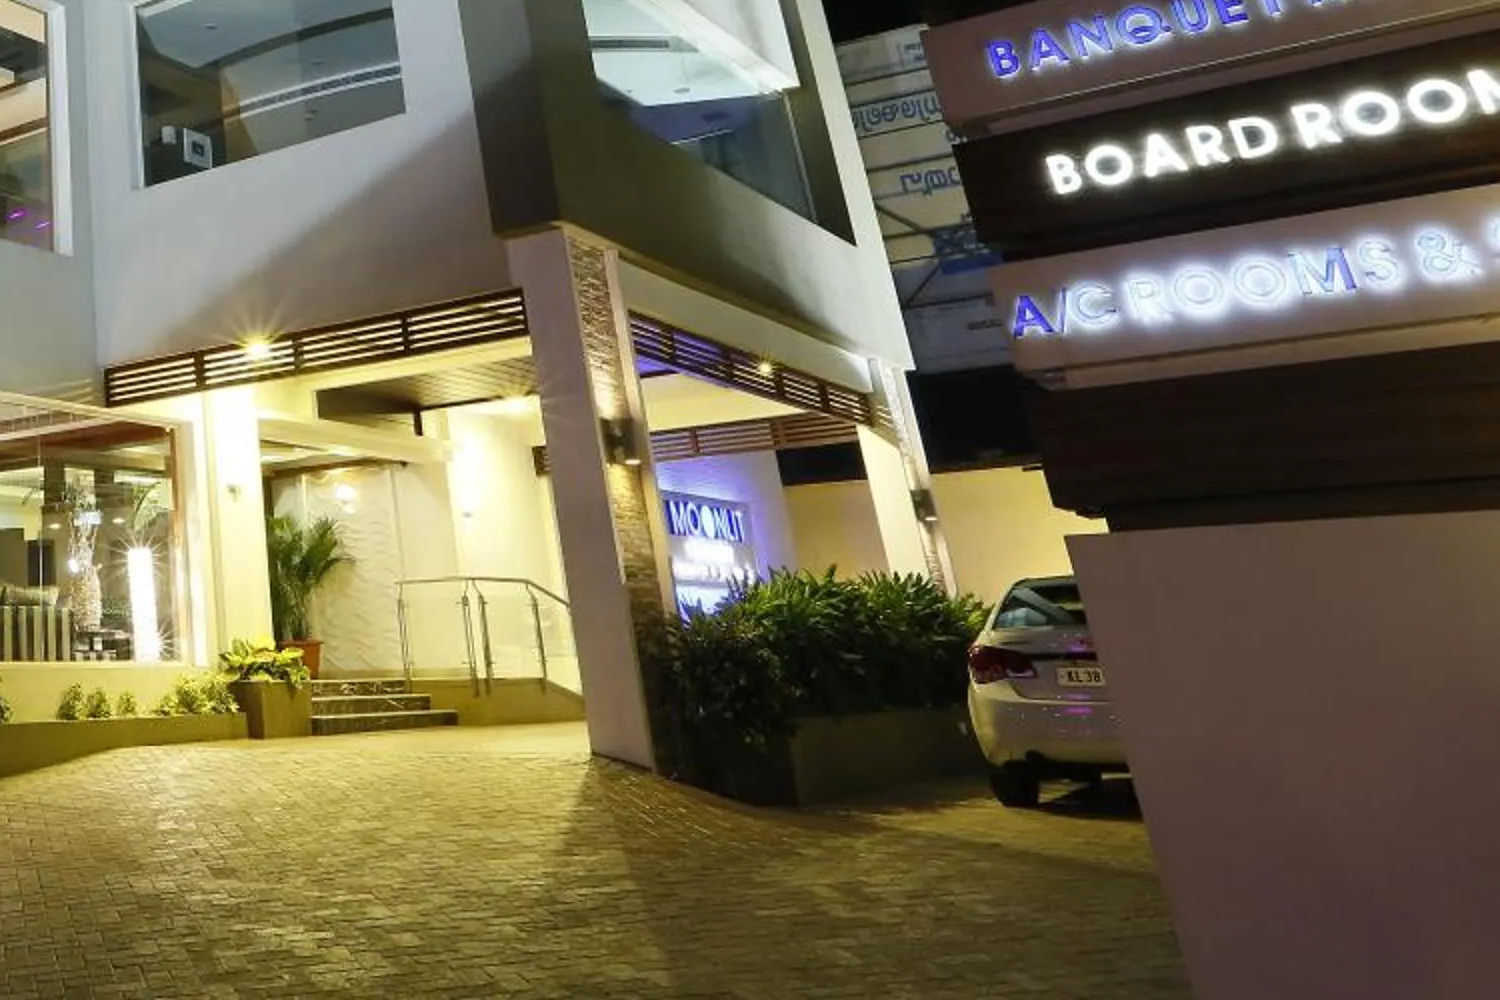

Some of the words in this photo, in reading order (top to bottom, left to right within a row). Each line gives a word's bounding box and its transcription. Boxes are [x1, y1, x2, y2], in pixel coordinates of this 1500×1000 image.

[1046, 115, 1279, 196] BOARD
[1012, 280, 1118, 338] A/C
[1123, 235, 1404, 320] ROOMS
[1416, 229, 1485, 278] &
[663, 499, 744, 542] MOONLIT
